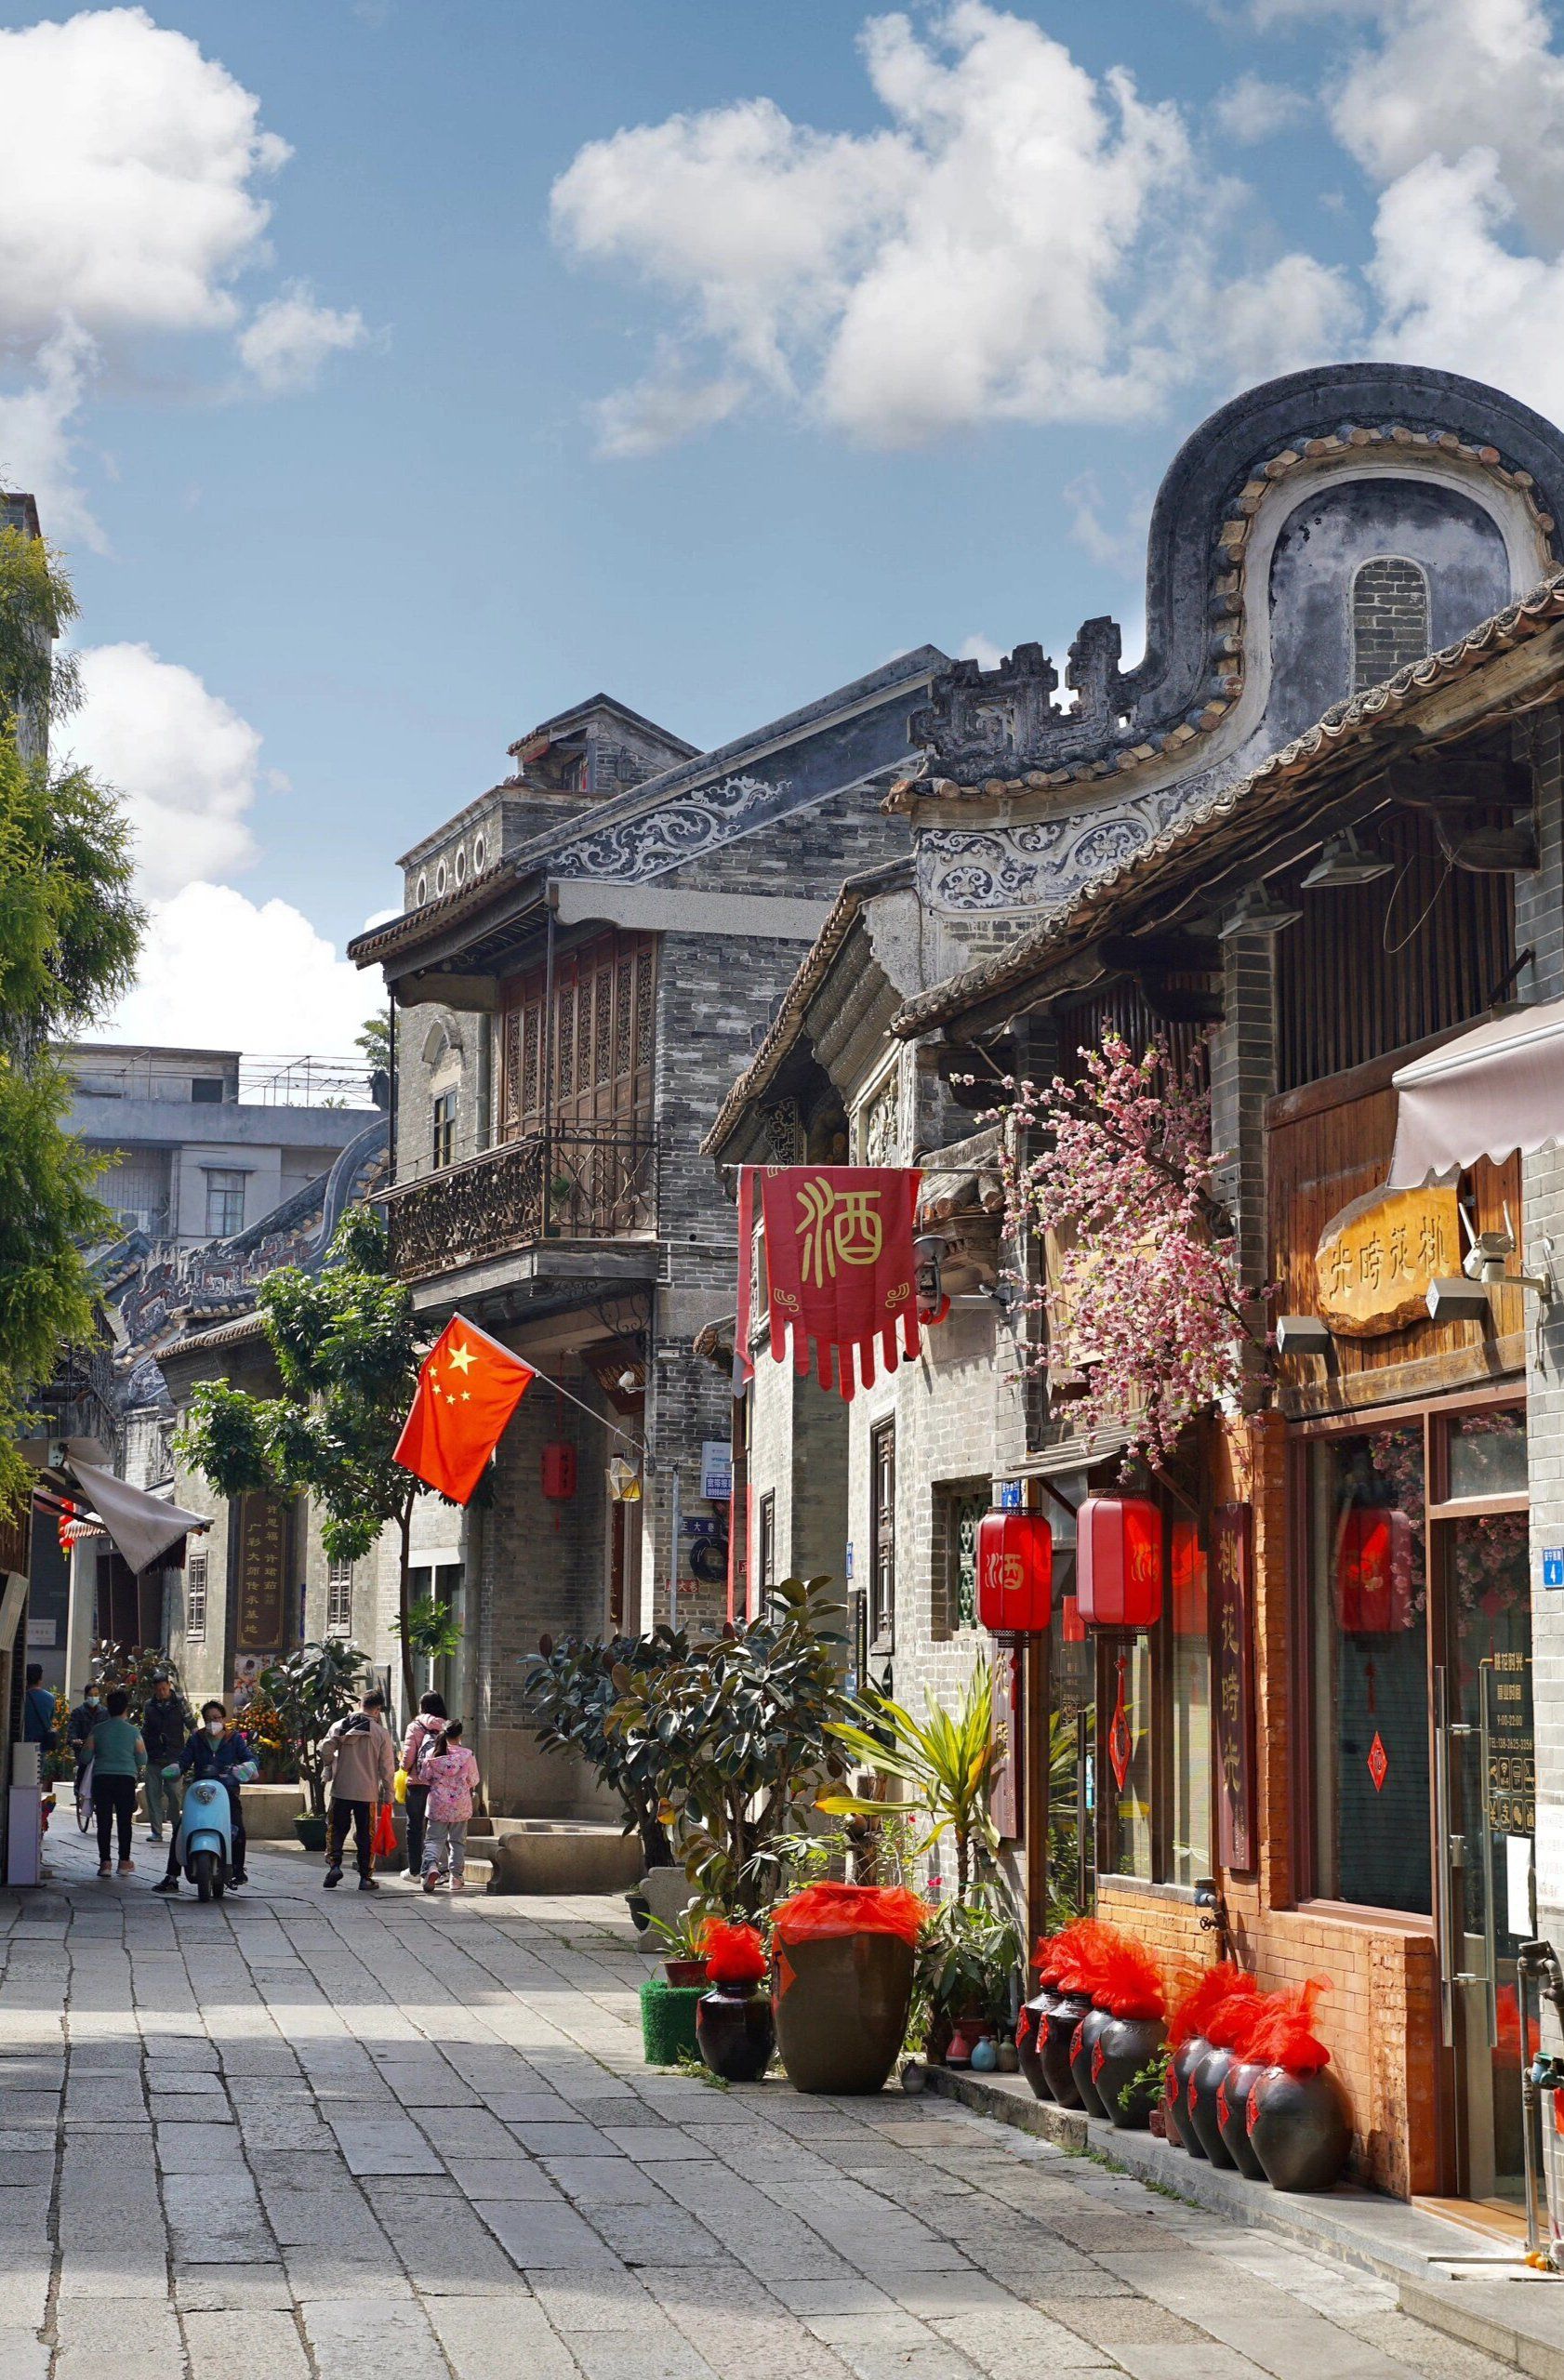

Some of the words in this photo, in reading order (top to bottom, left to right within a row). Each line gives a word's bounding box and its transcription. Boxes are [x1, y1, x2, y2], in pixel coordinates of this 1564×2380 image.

[795, 1176, 881, 1289] 酒
[245, 1523, 261, 1633] 广彩大师传承基地
[985, 1552, 1025, 1591] 酒
[1550, 1563, 1557, 1583] 4
[1497, 1684, 1522, 1700] 营业时间
